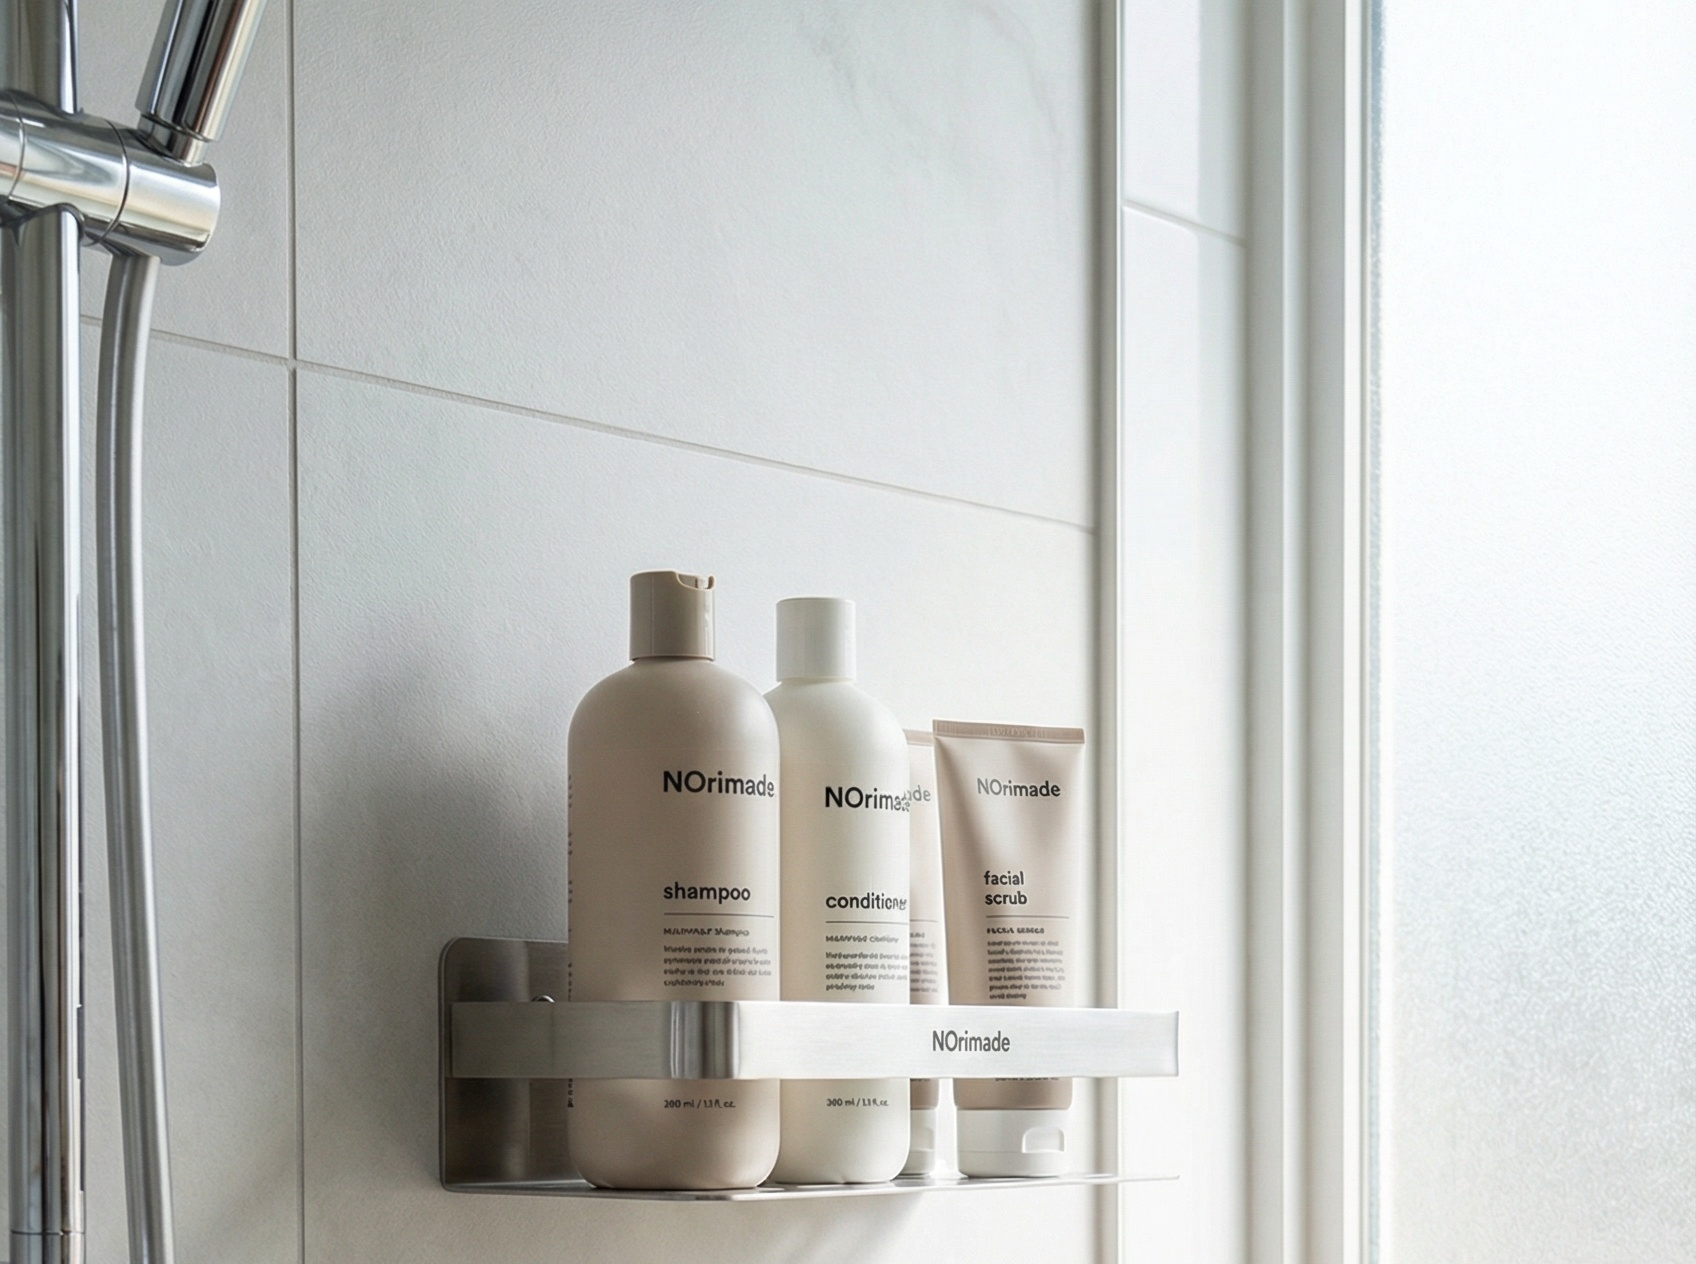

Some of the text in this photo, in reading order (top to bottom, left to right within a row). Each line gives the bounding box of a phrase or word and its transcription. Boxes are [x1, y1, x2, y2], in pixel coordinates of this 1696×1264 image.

[663, 770, 775, 798] NOrimade
[977, 777, 1061, 797] NOrimade
[983, 870, 1025, 886] facial
[663, 881, 751, 905] shampoo
[984, 890, 1028, 906] scrub
[932, 1030, 1011, 1052] NOrimade
